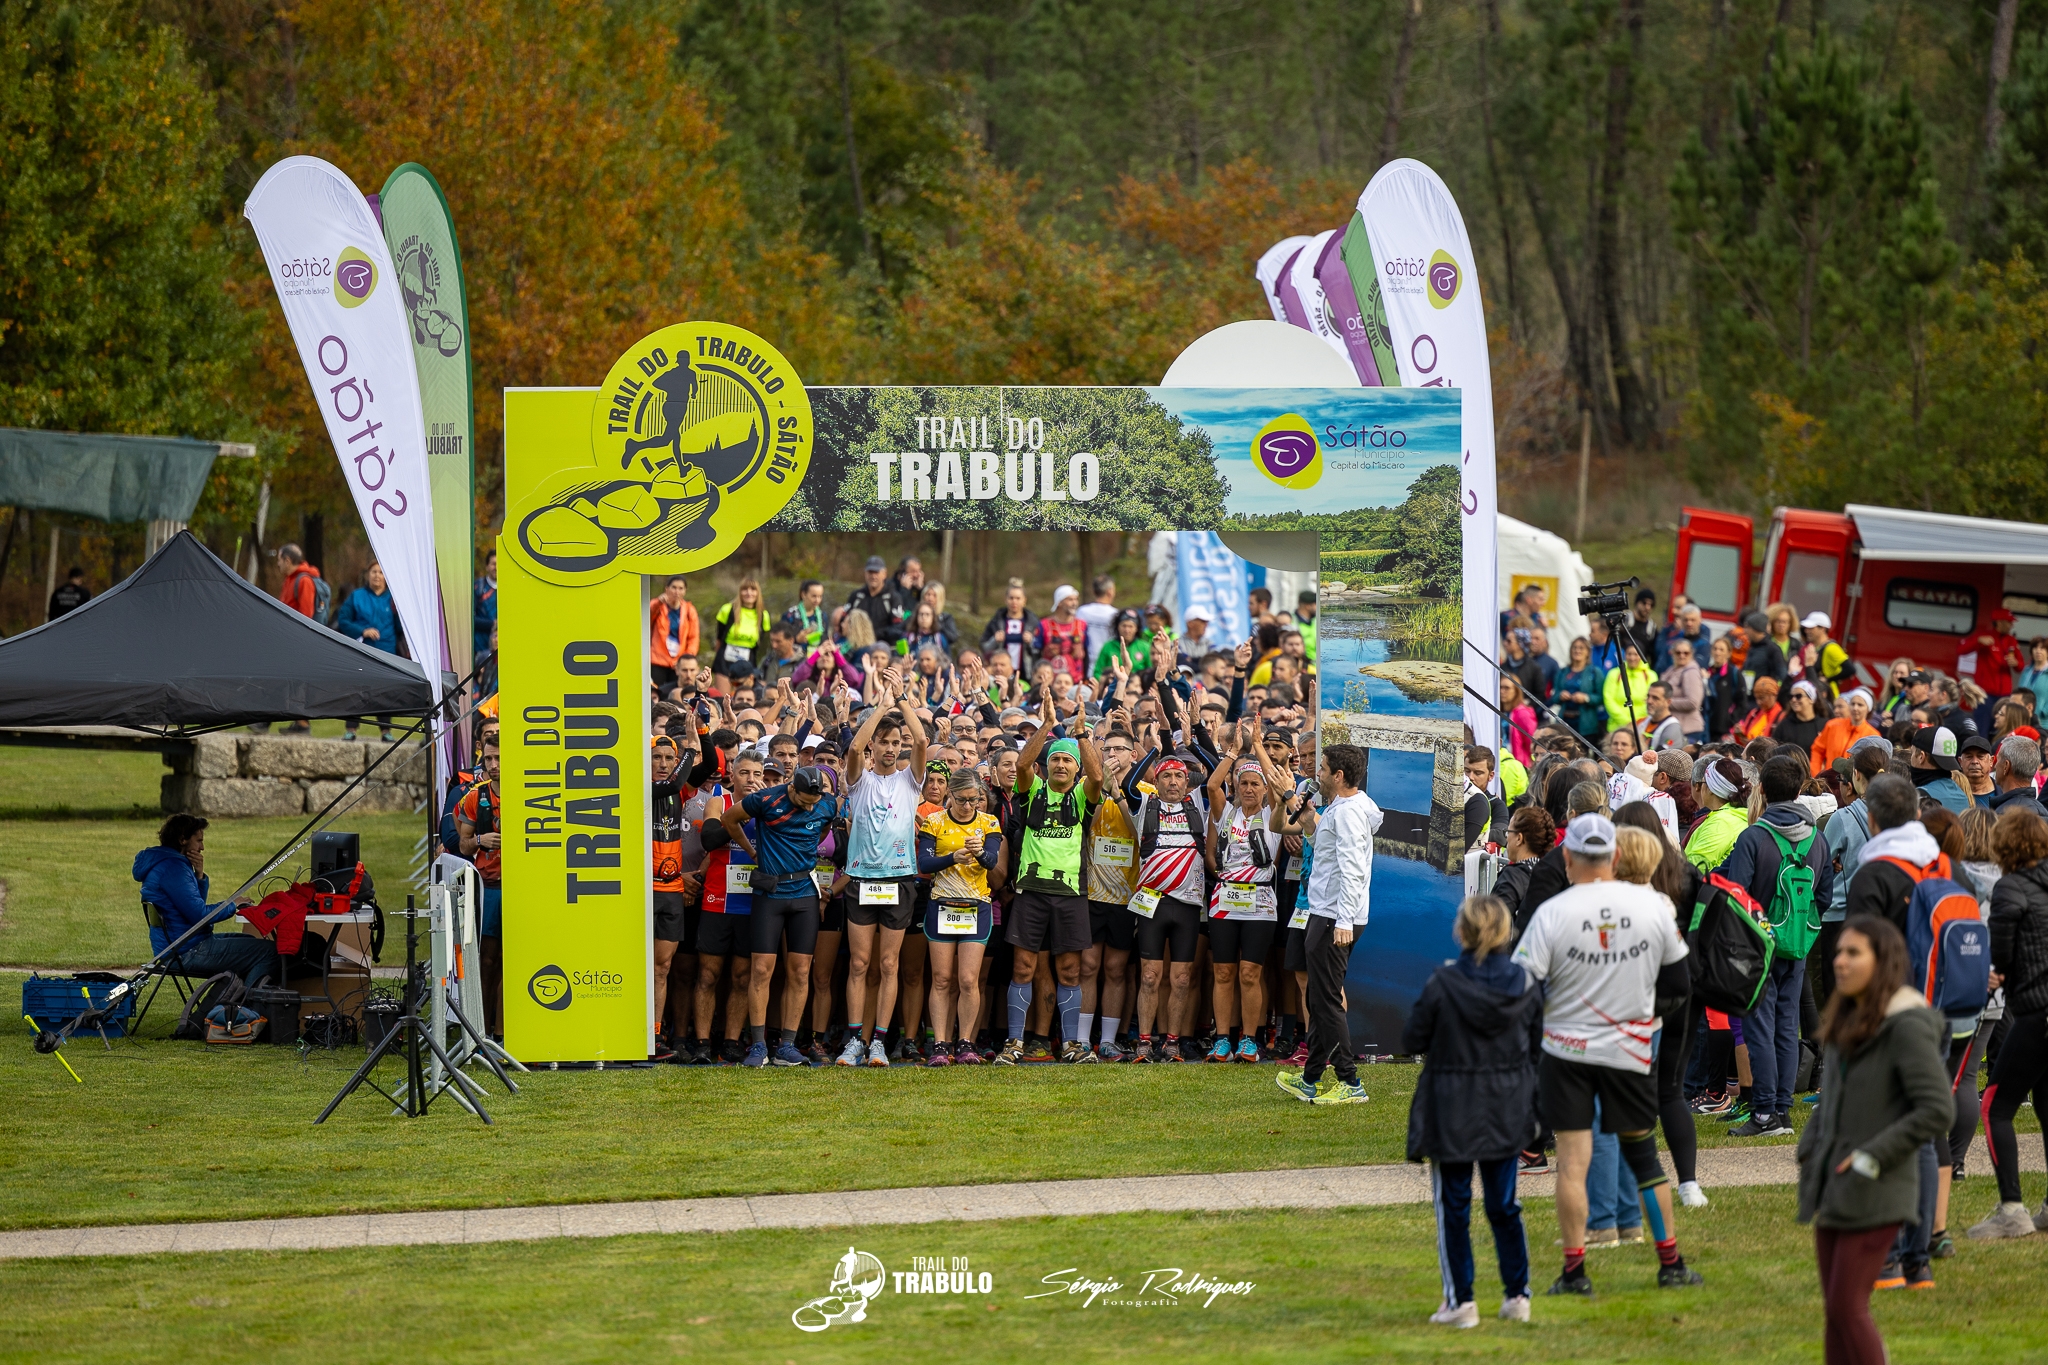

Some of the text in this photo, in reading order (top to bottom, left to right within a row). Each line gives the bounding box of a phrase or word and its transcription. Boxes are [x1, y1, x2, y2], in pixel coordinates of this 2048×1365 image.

[608, 376, 644, 434] TRAIL
[637, 347, 669, 377] DO
[696, 336, 785, 394] TRABULO
[766, 416, 804, 484] SÁTÃO
[915, 416, 1044, 450] TRAIL DO
[1324, 424, 1407, 448] Sátão
[870, 451, 1100, 501] TRABULO
[1331, 461, 1359, 471] Capital
[1360, 461, 1371, 470] do
[522, 705, 562, 853] TRAIL DO
[562, 640, 623, 904] TRABULO
[1103, 845, 1116, 853] 516
[736, 873, 748, 881] 671
[1226, 891, 1240, 900] 526
[946, 914, 961, 922] 800
[1567, 940, 1650, 966] SANTIAGO
[573, 970, 623, 986] Sátão
